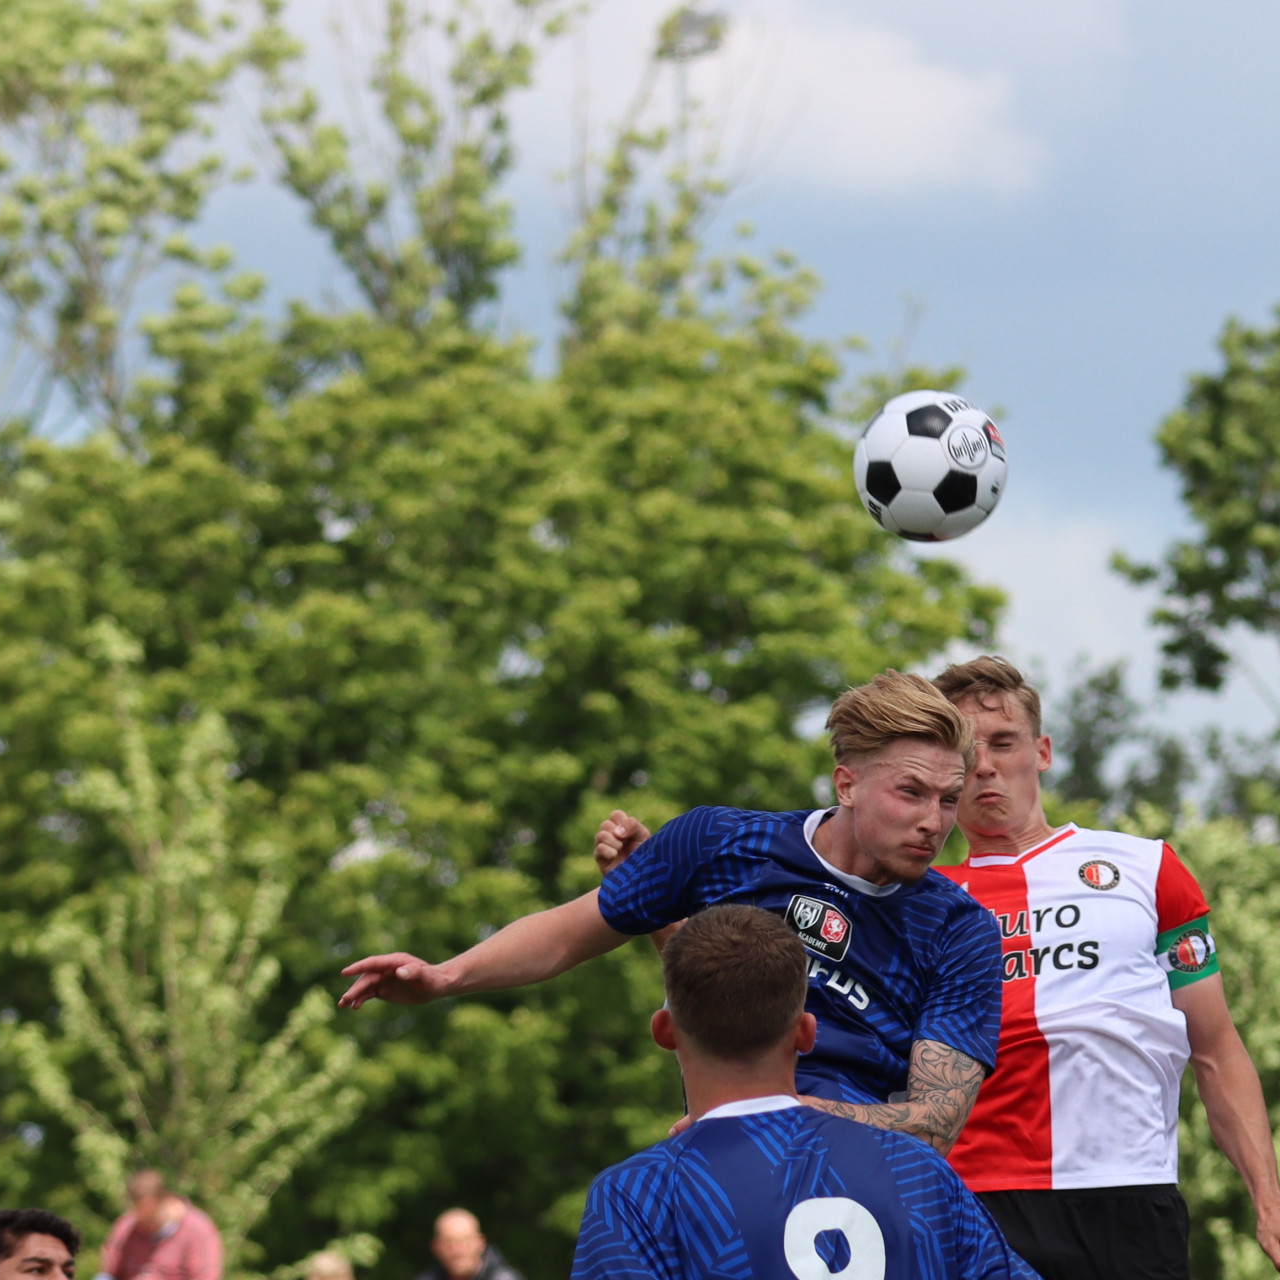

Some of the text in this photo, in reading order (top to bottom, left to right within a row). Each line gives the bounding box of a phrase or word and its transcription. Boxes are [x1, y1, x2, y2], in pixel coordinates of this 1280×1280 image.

[988, 904, 1080, 938] uro
[798, 931, 828, 951] ACADEMIE
[1002, 941, 1099, 982] arcs
